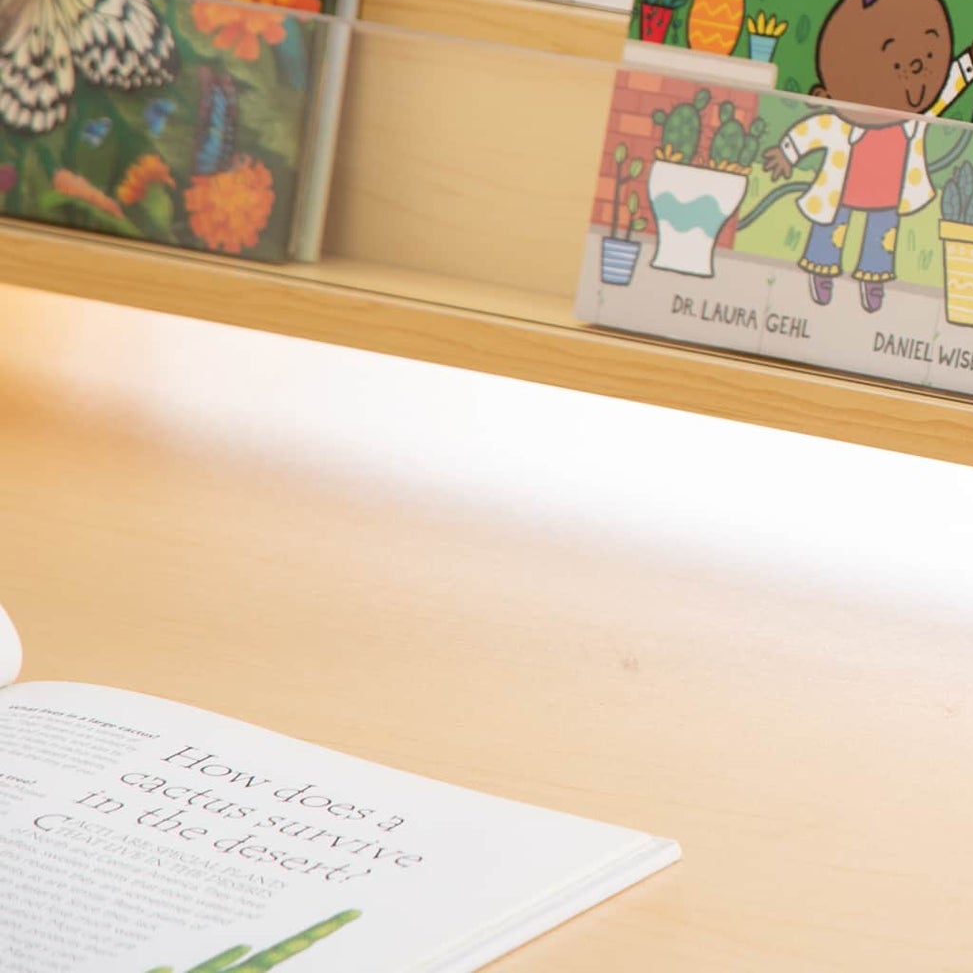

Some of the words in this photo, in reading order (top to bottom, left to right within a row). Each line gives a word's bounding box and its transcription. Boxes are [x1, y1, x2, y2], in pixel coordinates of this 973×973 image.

[671, 294, 696, 317] DR.
[701, 300, 758, 329] LAURA
[765, 313, 811, 339] GEHL
[873, 331, 933, 363] DANIEL
[120, 772, 255, 820] cactus
[256, 813, 423, 868] survive
[161, 745, 271, 788] How
[273, 783, 375, 820] does
[377, 815, 405, 832] a
[75, 790, 125, 815] in
[137, 808, 208, 840] the
[213, 834, 372, 884] desert?
